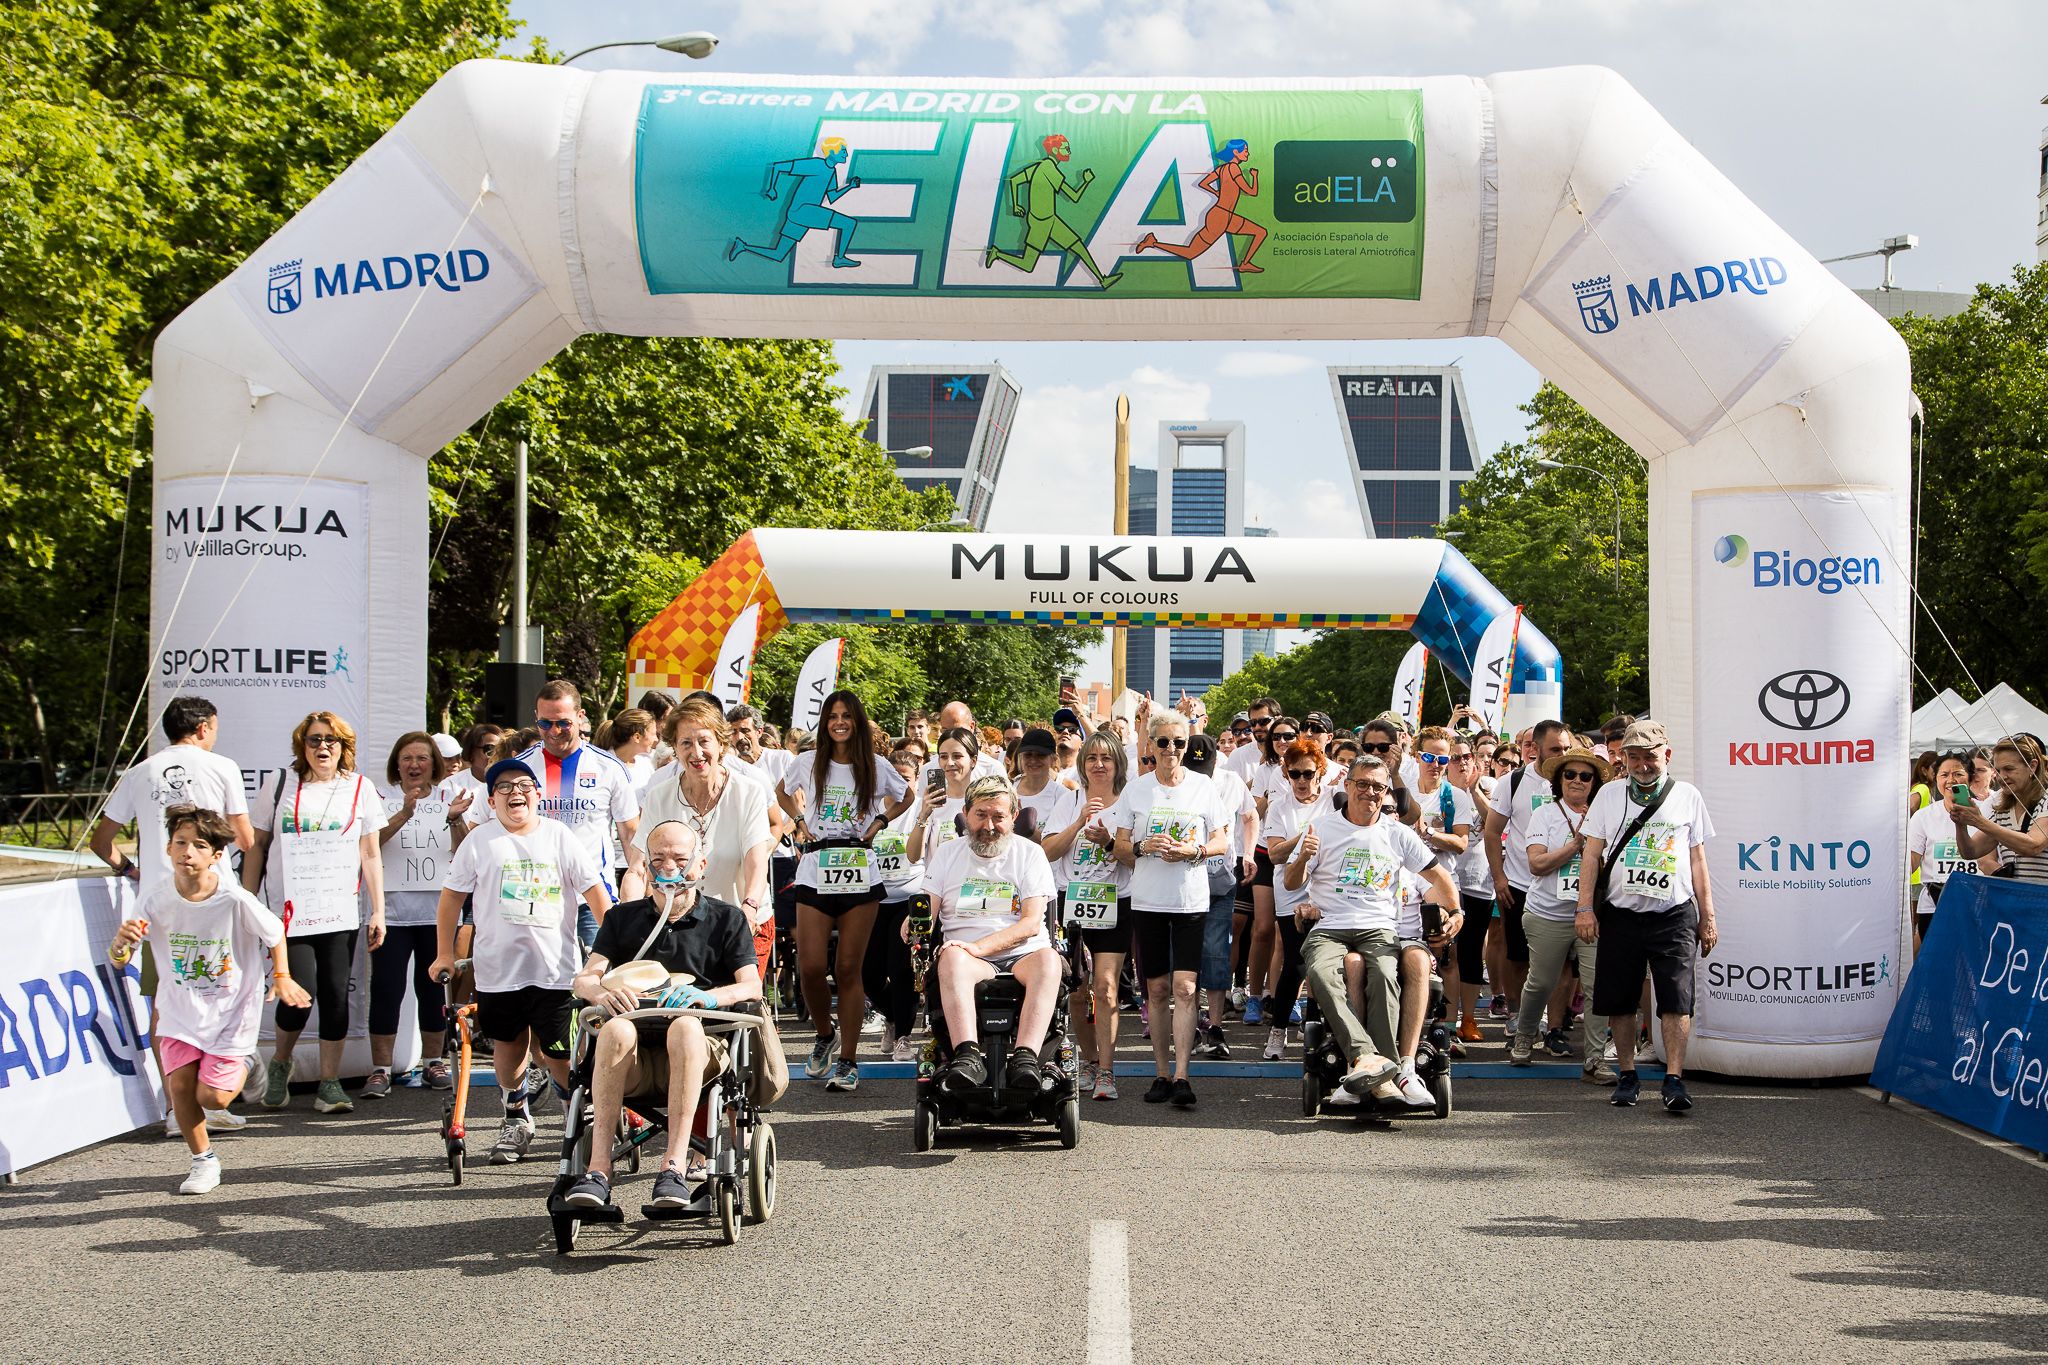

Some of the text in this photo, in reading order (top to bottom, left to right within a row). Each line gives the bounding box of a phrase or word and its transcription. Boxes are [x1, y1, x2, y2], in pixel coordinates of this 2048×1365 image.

[656, 89, 1208, 116] 3ª Carrera MADRID CON LA
[1294, 175, 1396, 203] adELA
[787, 116, 1243, 292] ELA
[1273, 232, 1389, 243] Asociación Española de
[1273, 247, 1416, 257] Esclerosis Lateral Amiotrófica
[314, 249, 490, 298] MADRID
[1626, 256, 1788, 317] MADRID
[1346, 377, 1436, 396] REALIA
[166, 505, 348, 538] MUKUA
[166, 539, 307, 563] by VelillaGroup.
[951, 543, 1256, 583] MUKUA
[1753, 550, 1881, 594] Biogen
[1029, 591, 1179, 605] FULL OF COLOURS
[162, 648, 327, 675] SPORTLIFE
[199, 677, 271, 687] COMUNICACIÓN
[272, 679, 279, 687] Y
[281, 679, 326, 688] EVENTOS
[537, 795, 596, 811] mirates
[400, 828, 440, 849] ELA
[406, 856, 436, 882] NO
[827, 852, 858, 866] ELA
[877, 856, 901, 871] 42
[1937, 861, 1978, 875] 1788
[824, 869, 864, 884] 1791
[1562, 878, 1579, 892] 14
[1626, 869, 1670, 889] 1466
[1738, 877, 1872, 891] Flexible Mobility Solutions
[529, 902, 534, 915] 1
[980, 898, 987, 910] 1
[1074, 902, 1108, 919] 857
[1980, 921, 2029, 995] De
[1707, 961, 1876, 991] SPORTLIFE
[1709, 990, 1875, 1004] MOVILIDAD, COMUNICACIÓN Y EVENTOS
[0, 963, 152, 1090] ADRID
[1952, 1020, 2048, 1112] al Ciel
